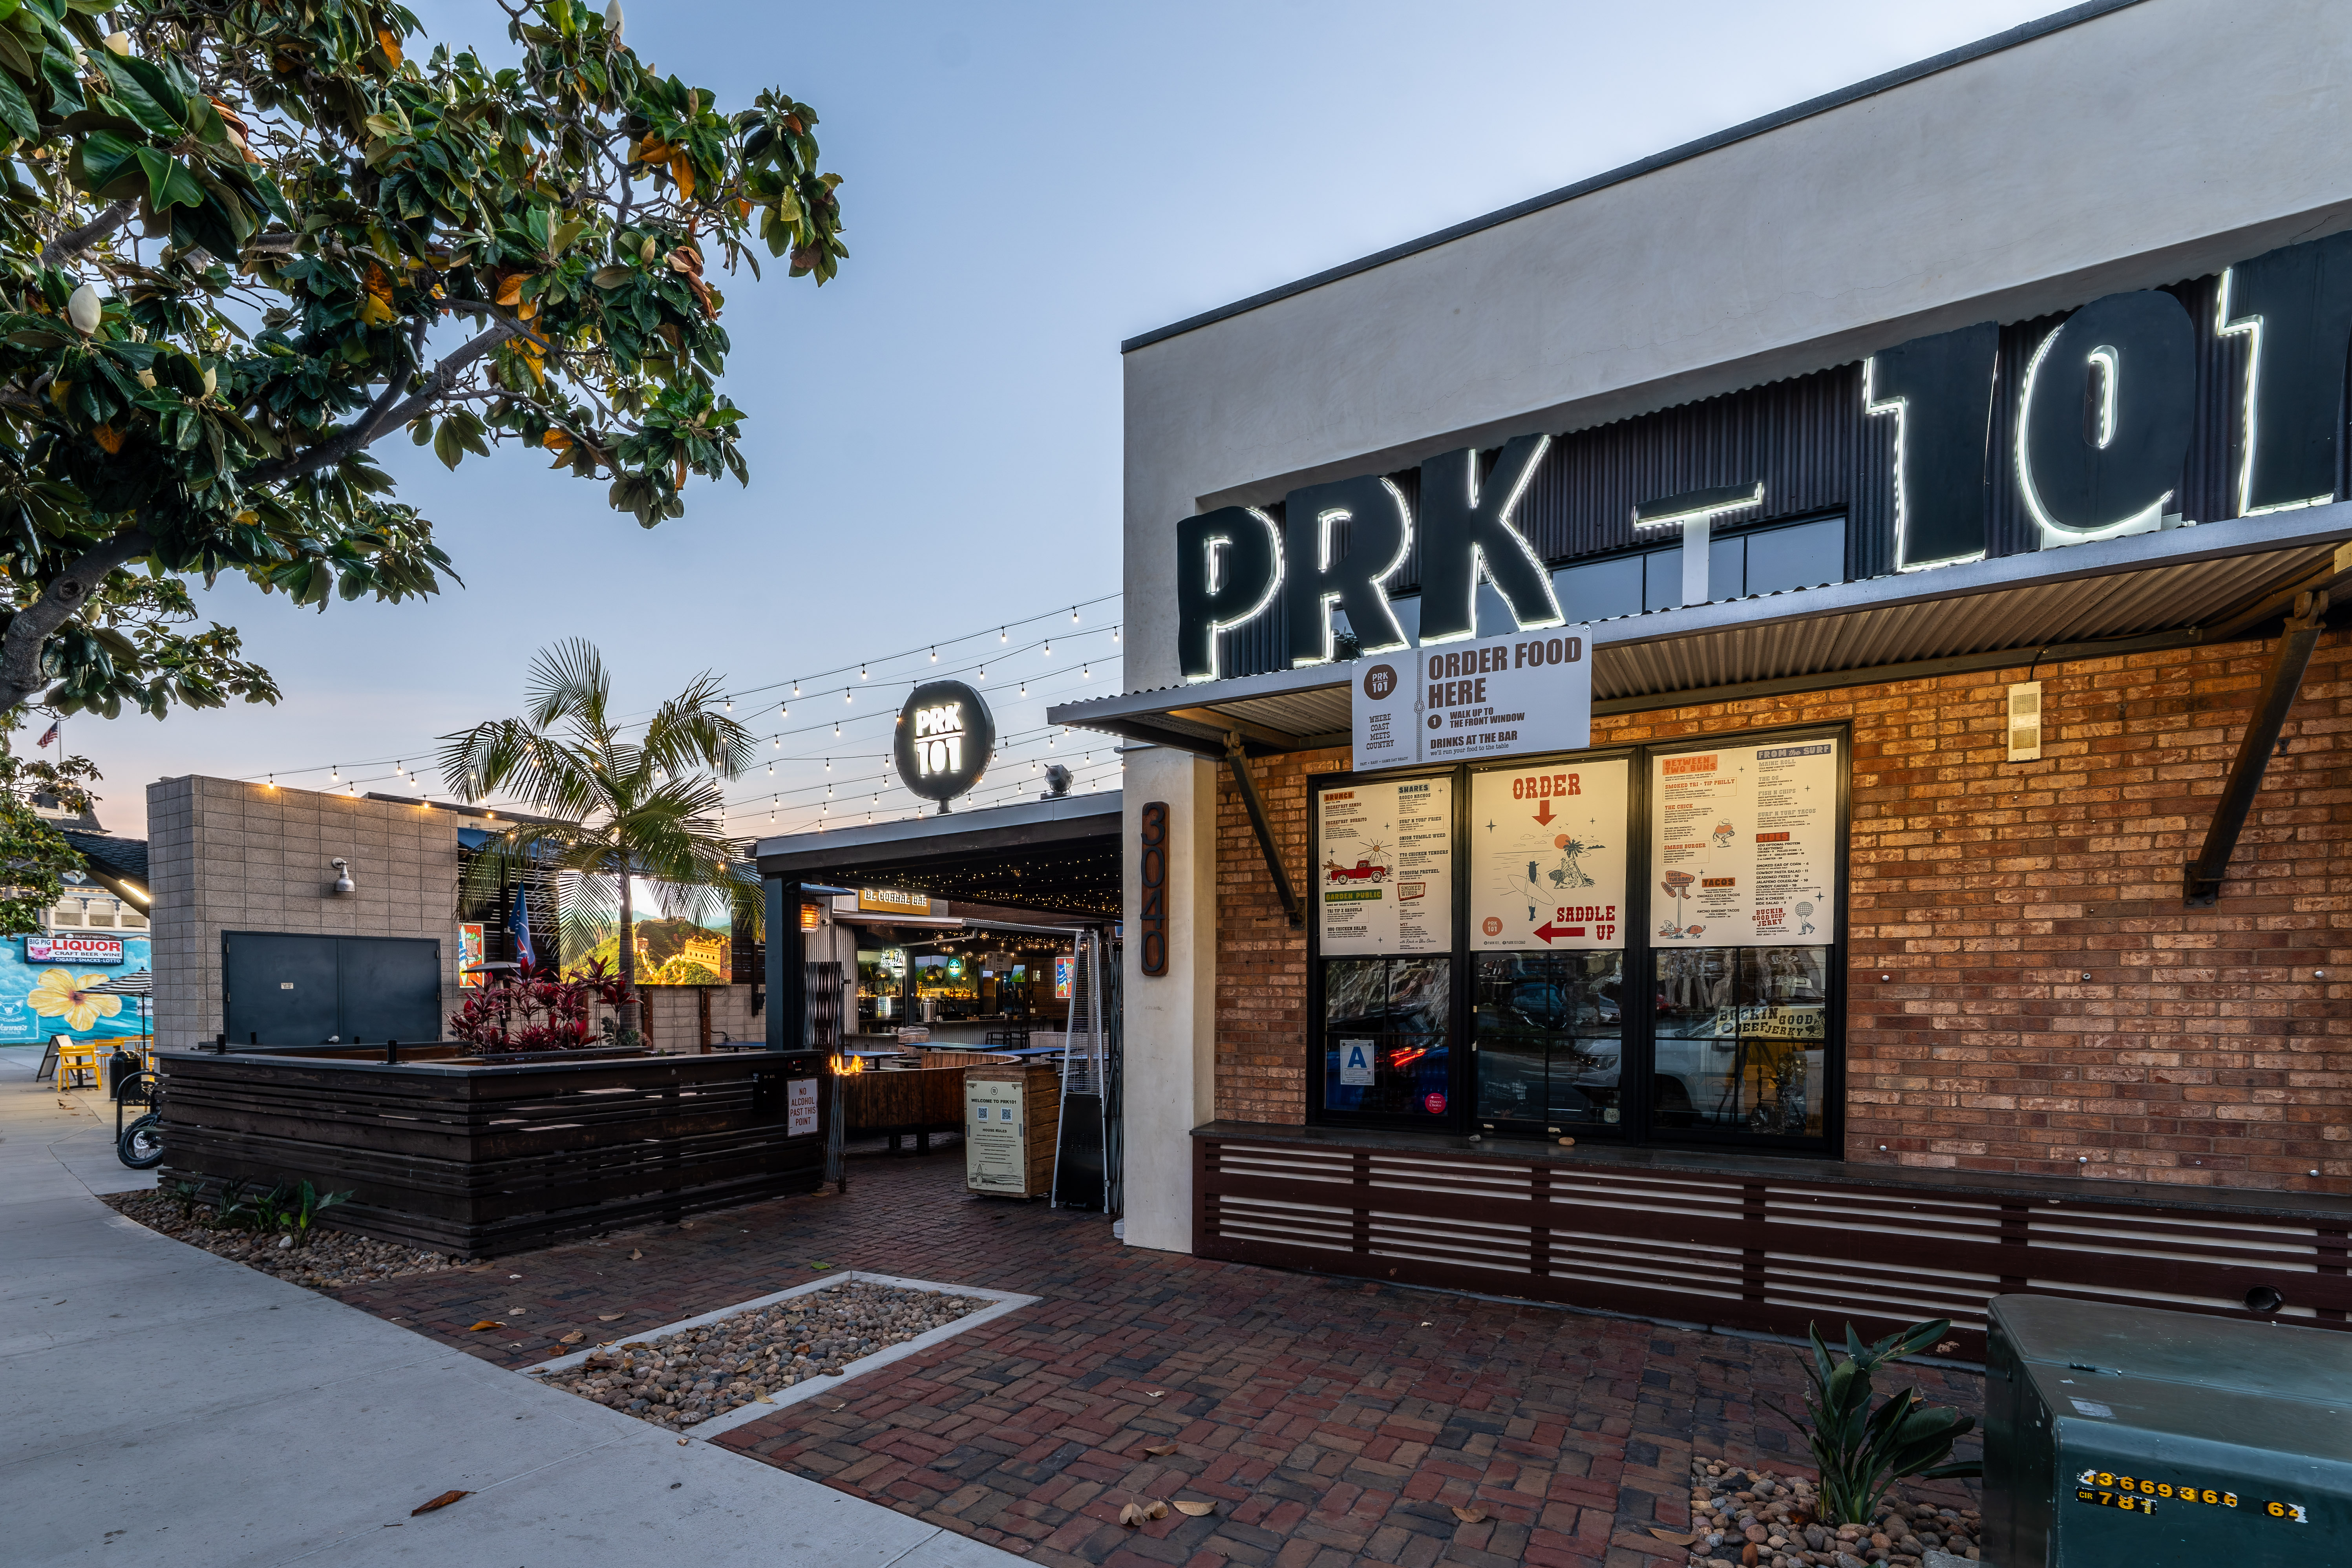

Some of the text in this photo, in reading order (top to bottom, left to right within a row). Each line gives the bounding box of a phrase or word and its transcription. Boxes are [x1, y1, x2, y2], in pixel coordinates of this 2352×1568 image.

[1176, 228, 2352, 683] PRK 101
[1429, 637, 1581, 680] ORDER FOOD
[1372, 672, 1388, 681] PRK
[1373, 681, 1387, 693] 101
[1429, 678, 1486, 709] HERE
[1369, 713, 1391, 723] WHERE
[1450, 707, 1493, 719] WALK UP TO
[916, 704, 962, 736] PRK
[1450, 713, 1525, 728] THE FRONT WINDOW
[1371, 722, 1389, 731] COAST
[1370, 731, 1390, 740] MEETS
[1431, 731, 1517, 749] DRINKS AT THE BAR
[1367, 740, 1394, 750] COUNTRY
[917, 737, 961, 775] 101
[1758, 749, 1786, 758] FROM
[1804, 746, 1829, 755] SURF
[1665, 757, 1709, 767] BETWEEN
[1690, 763, 1716, 771] BUNS
[1399, 785, 1428, 793] SHARES
[1513, 773, 1581, 799] ORDER
[1325, 792, 1352, 800] BRUNCH
[1757, 833, 1788, 841] SIDES
[1140, 804, 1166, 971] 3040
[864, 890, 876, 901] EL
[1557, 905, 1616, 922] SADDLE
[1596, 925, 1615, 940] UP
[53, 940, 121, 952] LIQUOR
[1779, 1014, 1813, 1025] GOOD
[1765, 1025, 1804, 1036] JERKY
[1347, 1046, 1367, 1068] A
[791, 1097, 815, 1106] ALCOHOL
[790, 1106, 816, 1117] PAST THIS
[796, 1117, 811, 1126] POINT
[2079, 1491, 2152, 1515] CIR 781
